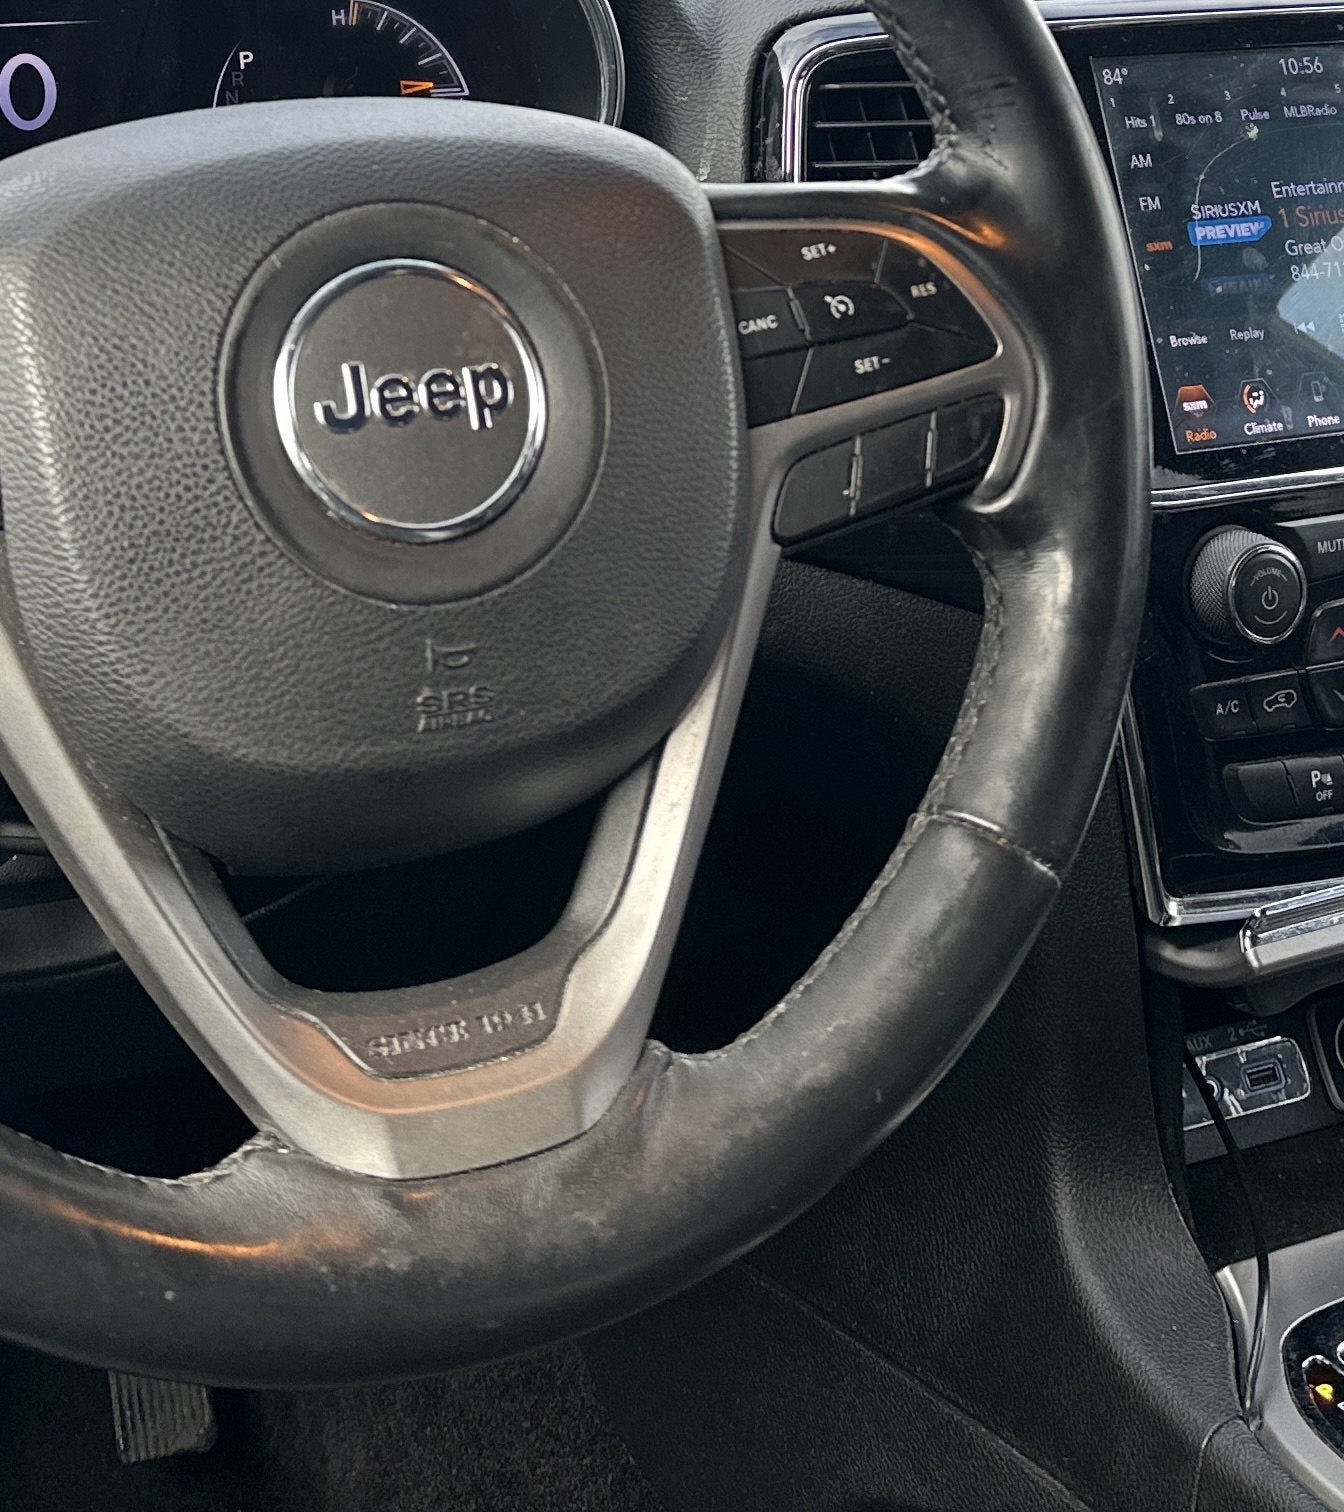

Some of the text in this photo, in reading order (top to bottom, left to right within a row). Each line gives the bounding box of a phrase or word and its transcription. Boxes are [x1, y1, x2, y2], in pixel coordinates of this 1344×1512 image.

[331, 9, 346, 26] H
[239, 51, 254, 69] P
[1278, 56, 1324, 76] 10:56
[1223, 90, 1232, 101] 3
[1280, 87, 1287, 97] 4
[1334, 83, 1342, 94] 5
[1167, 93, 1176, 105] 2
[1175, 110, 1223, 126] 80s on 8
[1239, 107, 1271, 121] Pulse
[1283, 103, 1338, 118] MLBRadio
[1125, 115, 1148, 129] Hits
[1130, 153, 1153, 169] AM
[1138, 196, 1162, 211] FM
[1190, 199, 1262, 220] SIRIUSXM
[1278, 207, 1289, 229] 1
[1194, 220, 1265, 240] PREVIEW
[1145, 240, 1173, 253] sxm
[1284, 237, 1327, 256] Great
[909, 282, 938, 299] RES
[738, 315, 778, 334] CANC
[1169, 333, 1209, 348] Browse
[1229, 327, 1265, 342] Replay
[313, 360, 515, 434] Jeep
[1243, 420, 1284, 436] Climate
[1306, 414, 1341, 428] Phone
[1184, 428, 1217, 444] Radio
[1215, 699, 1240, 716] A/C
[1315, 789, 1334, 802] OFF
